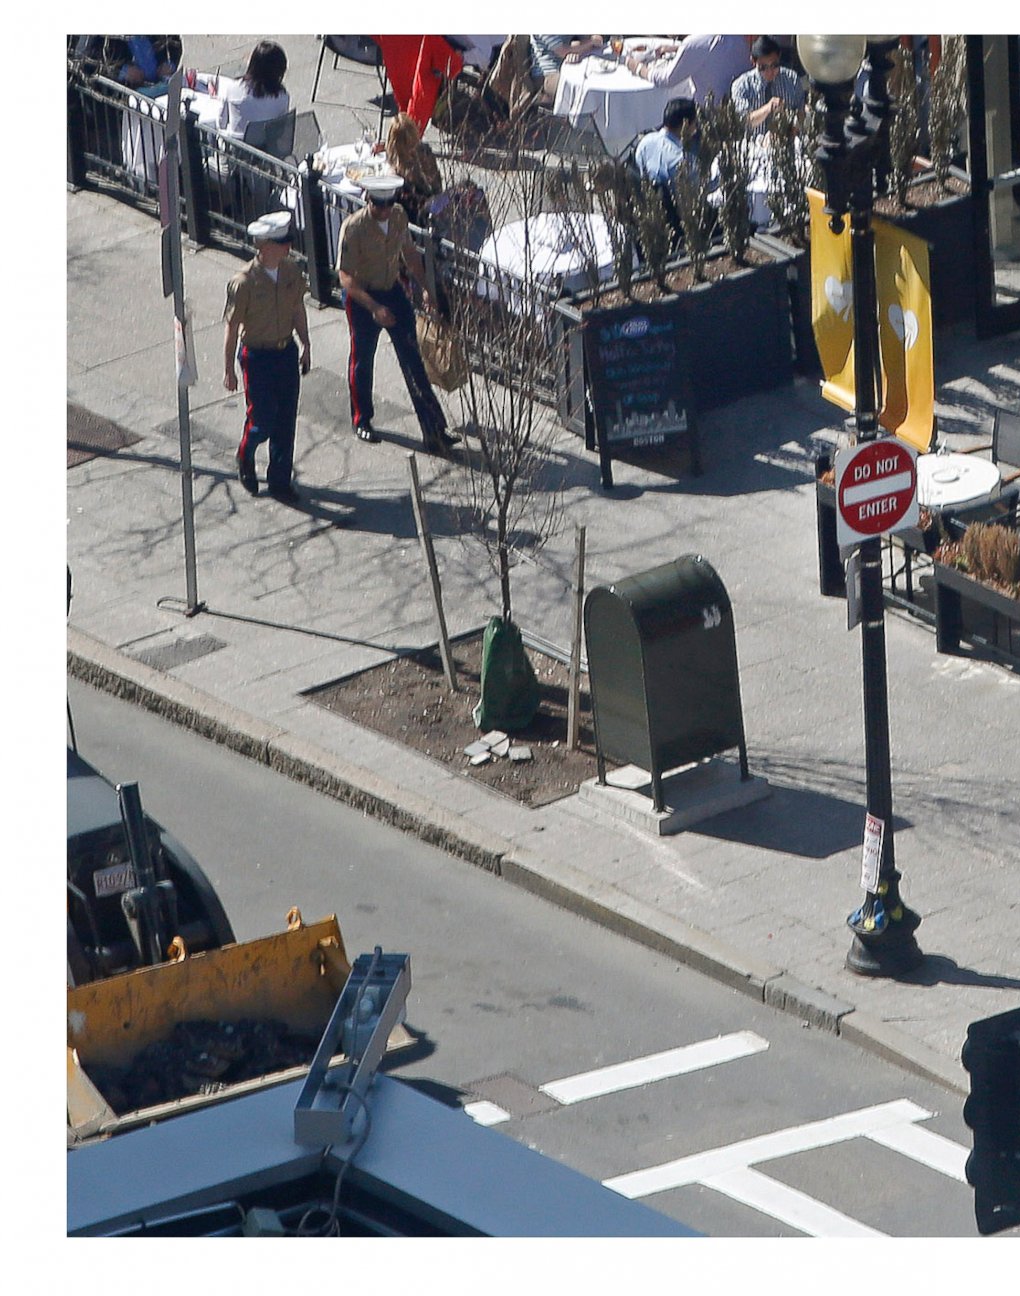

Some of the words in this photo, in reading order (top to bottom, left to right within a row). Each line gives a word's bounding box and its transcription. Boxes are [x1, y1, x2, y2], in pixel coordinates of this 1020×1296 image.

[854, 464, 871, 482] DO
[876, 455, 899, 475] NOT
[859, 497, 897, 520] ENTER
